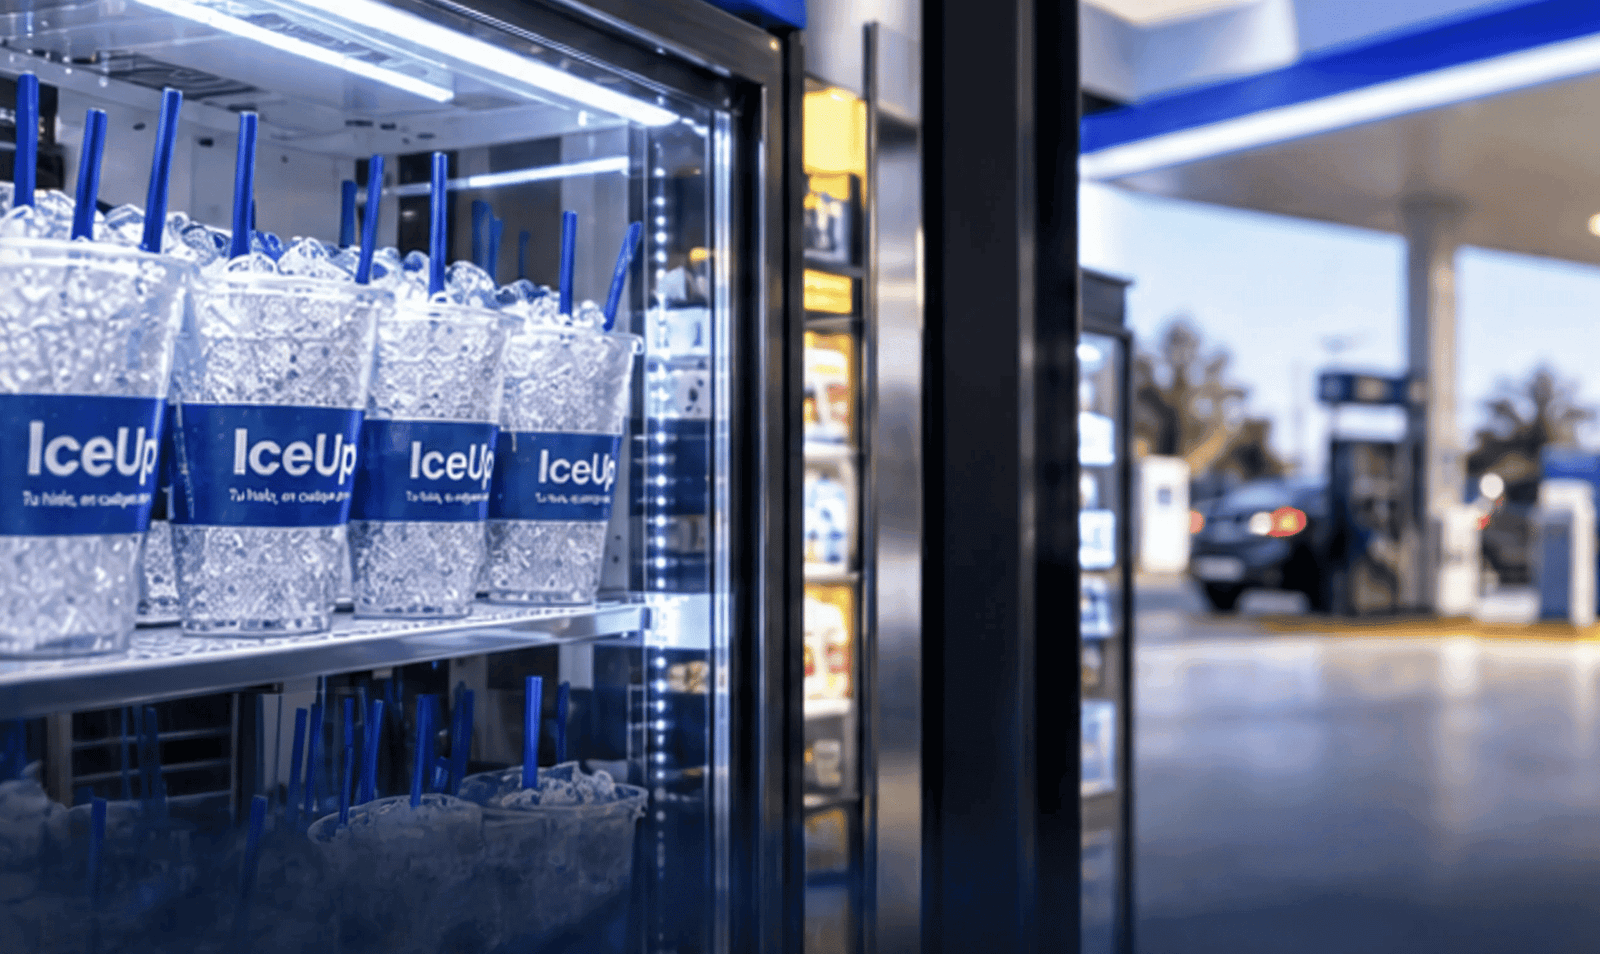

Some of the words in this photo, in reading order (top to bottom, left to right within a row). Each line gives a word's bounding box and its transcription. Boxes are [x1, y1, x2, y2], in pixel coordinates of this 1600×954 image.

[27, 420, 157, 486] IceUp
[233, 428, 357, 485] IceUp
[409, 440, 495, 491] IceUp
[538, 448, 616, 492] IceUp
